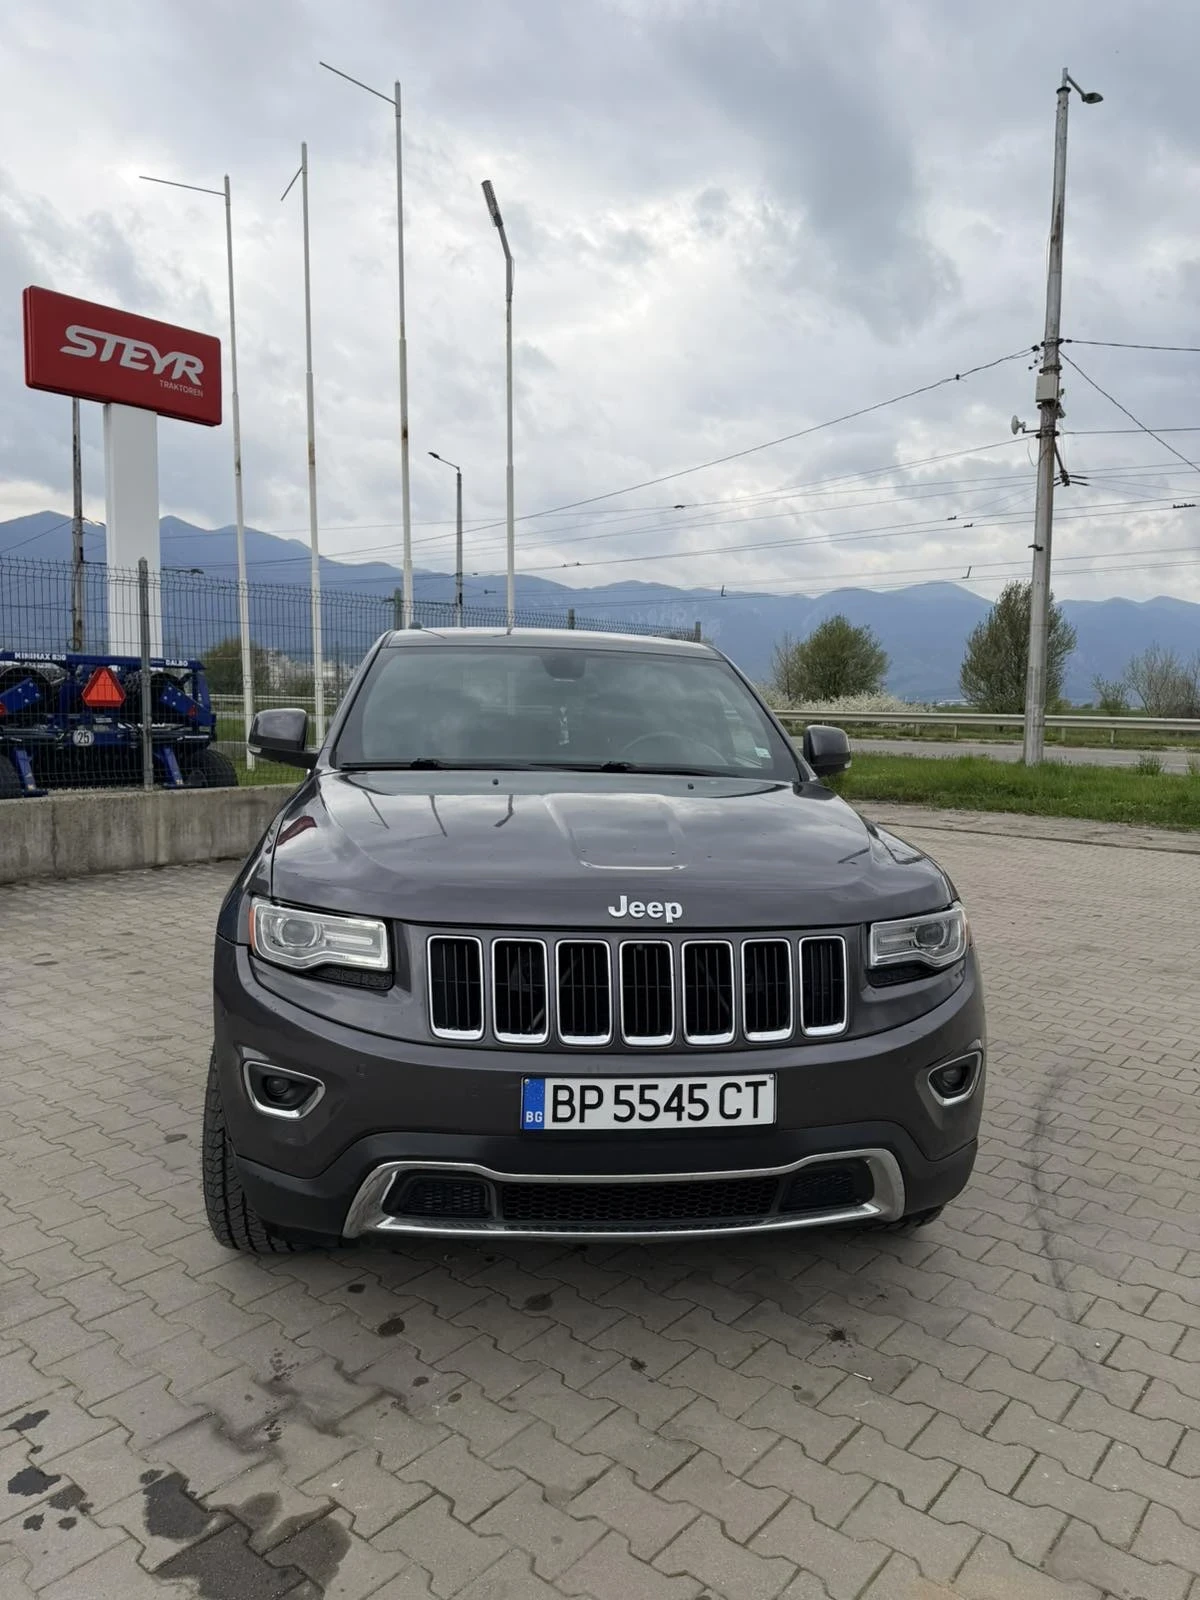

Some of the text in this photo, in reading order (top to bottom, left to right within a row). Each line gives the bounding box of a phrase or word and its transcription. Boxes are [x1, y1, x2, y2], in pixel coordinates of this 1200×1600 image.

[60, 325, 204, 386] STEYR
[159, 380, 203, 398] TRAKTOREN
[608, 895, 683, 923] Jeep
[551, 1080, 768, 1123] BP 5545 CT
[525, 1111, 543, 1123] BG
